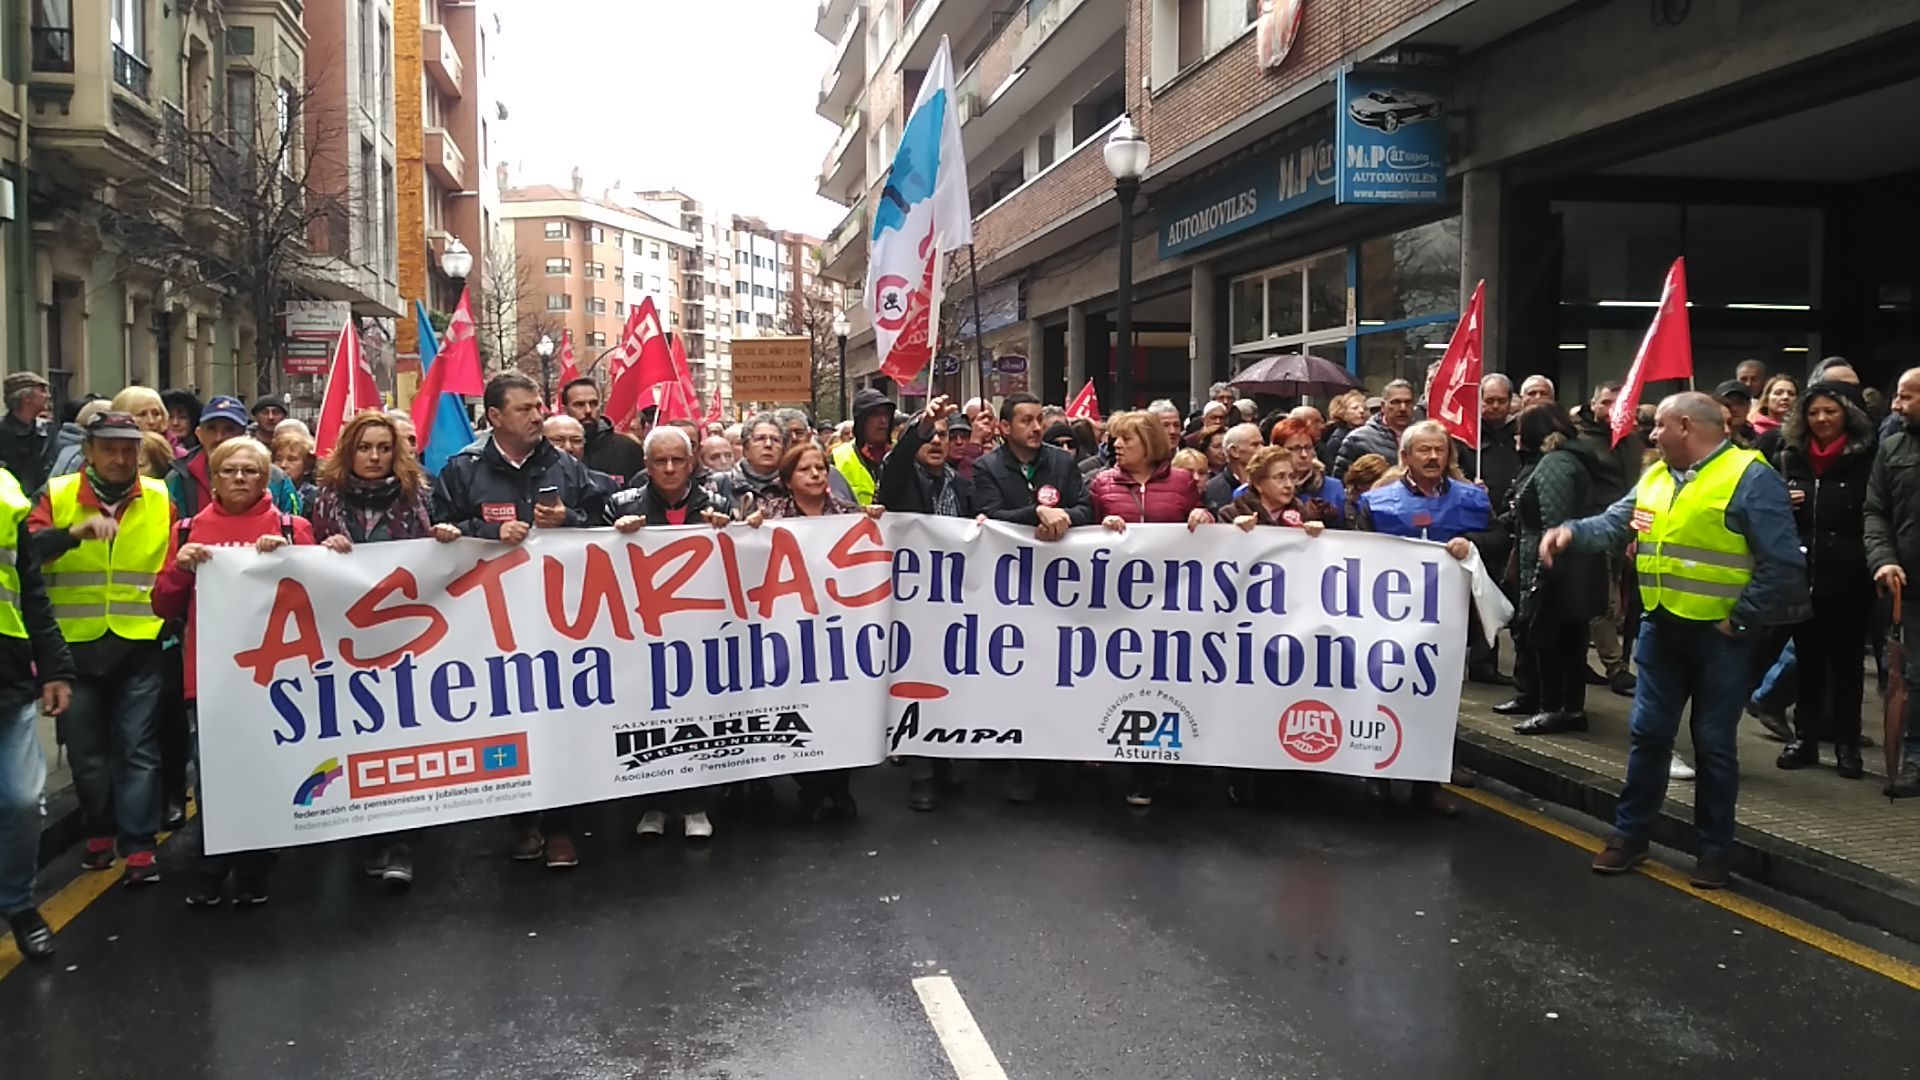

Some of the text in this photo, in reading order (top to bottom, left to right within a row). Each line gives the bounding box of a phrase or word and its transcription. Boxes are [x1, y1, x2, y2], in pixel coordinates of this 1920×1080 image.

[1353, 172, 1437, 183] AUTOMOVILES
[1167, 188, 1257, 247] AUTOMOVILES
[735, 375, 767, 383] NUESTRA
[752, 360, 803, 369] CONGELARON
[233, 516, 1440, 687] ASTURIAS en defensa del
[269, 614, 1438, 745] sistema público de pensiones
[612, 716, 694, 730] SALVEMOS
[729, 703, 809, 718] PENSIONES
[1098, 688, 1199, 738] Asociación de Pensionistas
[1286, 709, 1335, 736] UGT
[615, 711, 813, 757] MAREA
[1107, 710, 1183, 748] APA
[1350, 719, 1386, 739] UJP
[642, 735, 787, 760] PENSIONISTA
[1114, 746, 1180, 760] Asturias
[1349, 741, 1382, 752] Asturias
[357, 747, 475, 788] CCOO
[613, 749, 824, 782] Asociación de Pensionistes de Xixón
[293, 803, 347, 819] federación
[348, 802, 361, 812] de
[363, 794, 425, 811] pensionistas
[435, 786, 479, 801] jubilados
[481, 783, 494, 793] de
[496, 779, 532, 791] asturias
